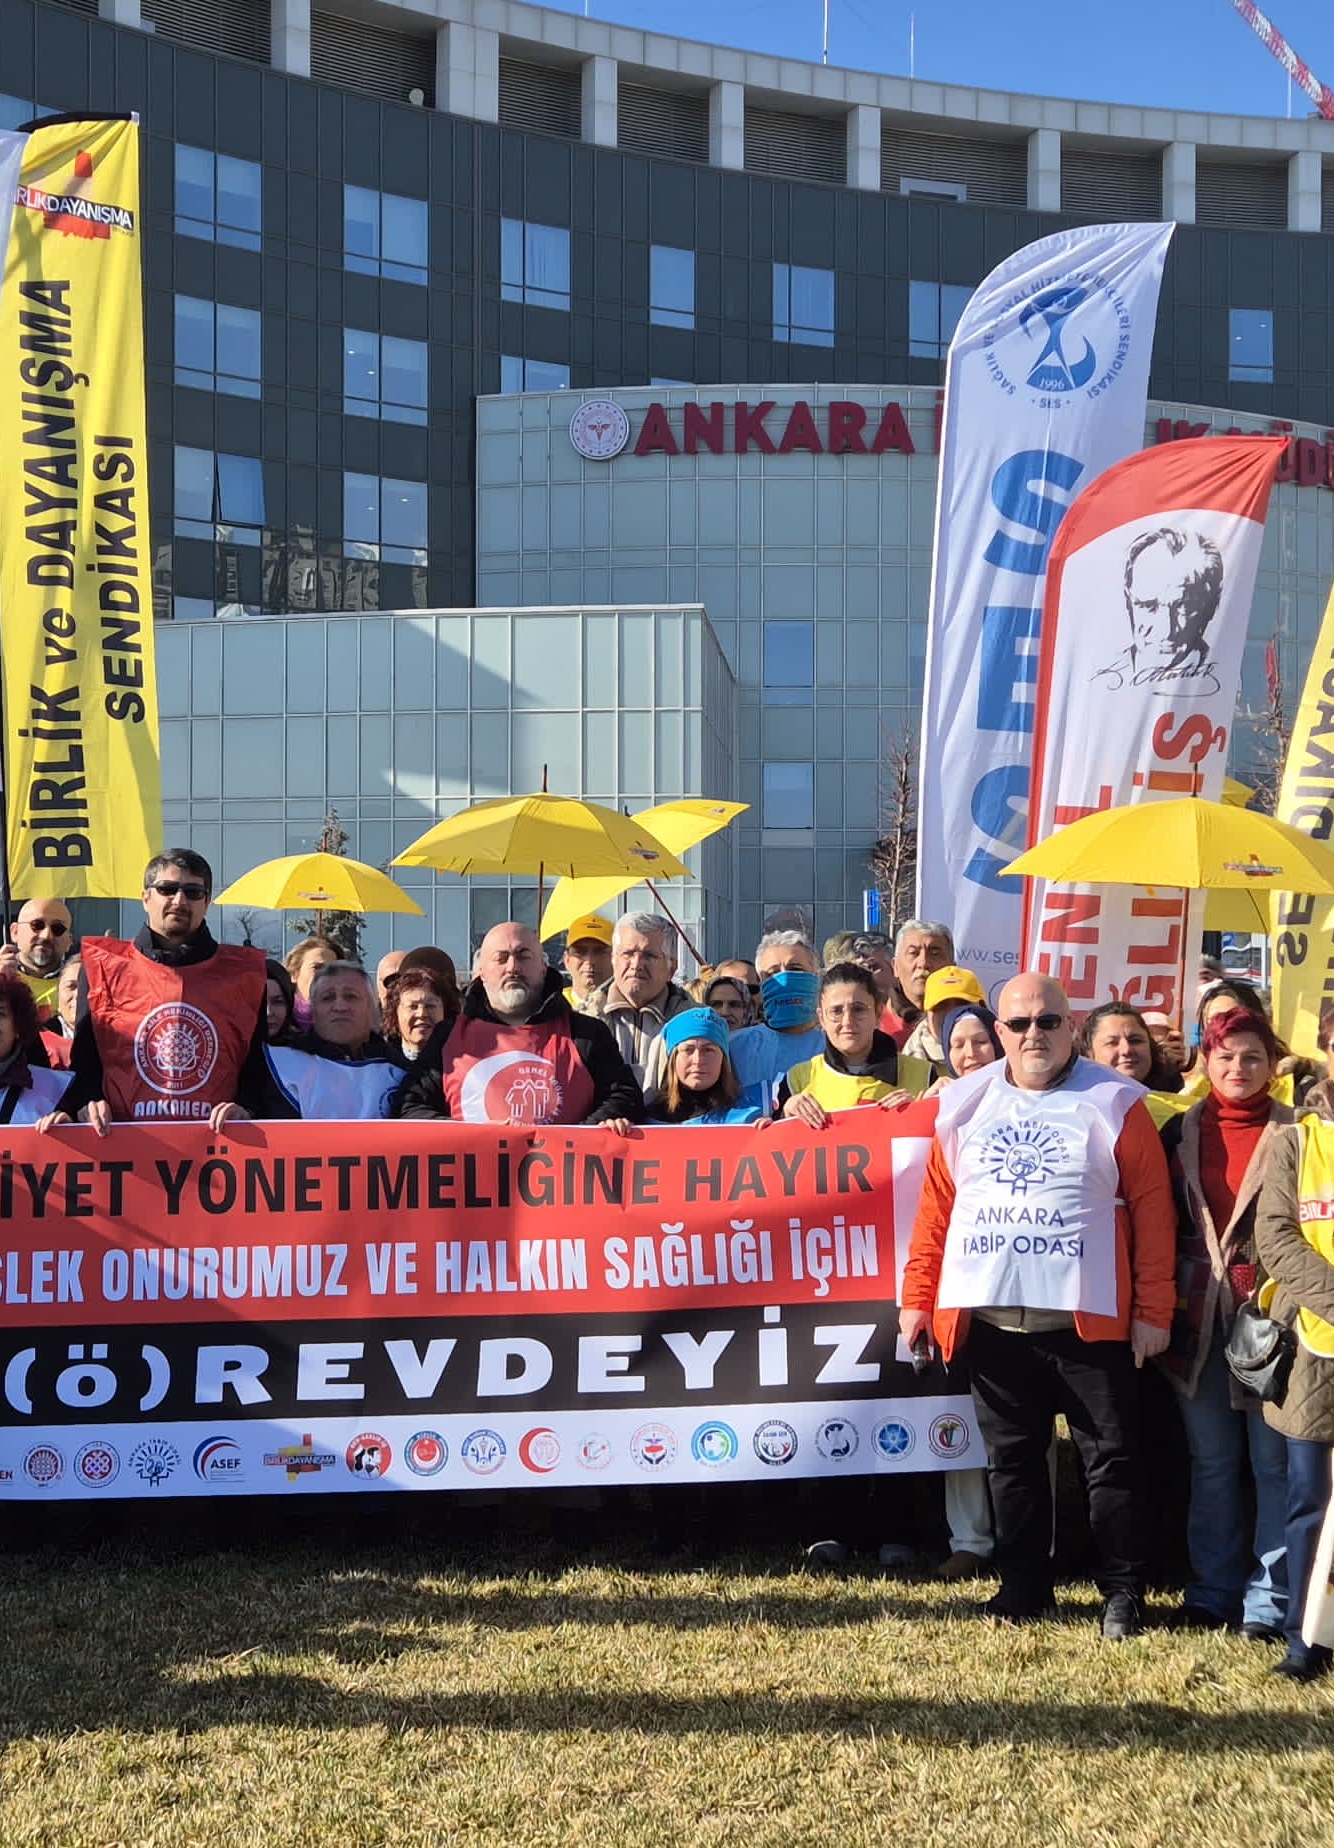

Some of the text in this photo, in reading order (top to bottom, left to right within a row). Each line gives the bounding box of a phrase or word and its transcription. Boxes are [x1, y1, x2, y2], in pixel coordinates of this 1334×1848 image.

[634, 400, 916, 456] ANKARA
[19, 280, 93, 869] BİRLİK ve DAYANIŞMA
[85, 434, 146, 724] SENDİKASI
[155, 1139, 660, 1215] YÖNETMELİĞİNE
[685, 1143, 875, 1202] HAYIR
[963, 1232, 1084, 1259] TABİP ODASI
[975, 1206, 1065, 1228] ANKARA
[102, 1243, 349, 1302] ONURUMUZ
[365, 1241, 418, 1296] VE
[436, 1238, 588, 1295] HALKIN
[604, 1218, 772, 1289] SAĞLIĞI
[788, 1214, 879, 1298] İÇİN
[210, 1458, 242, 1469] ASEF
